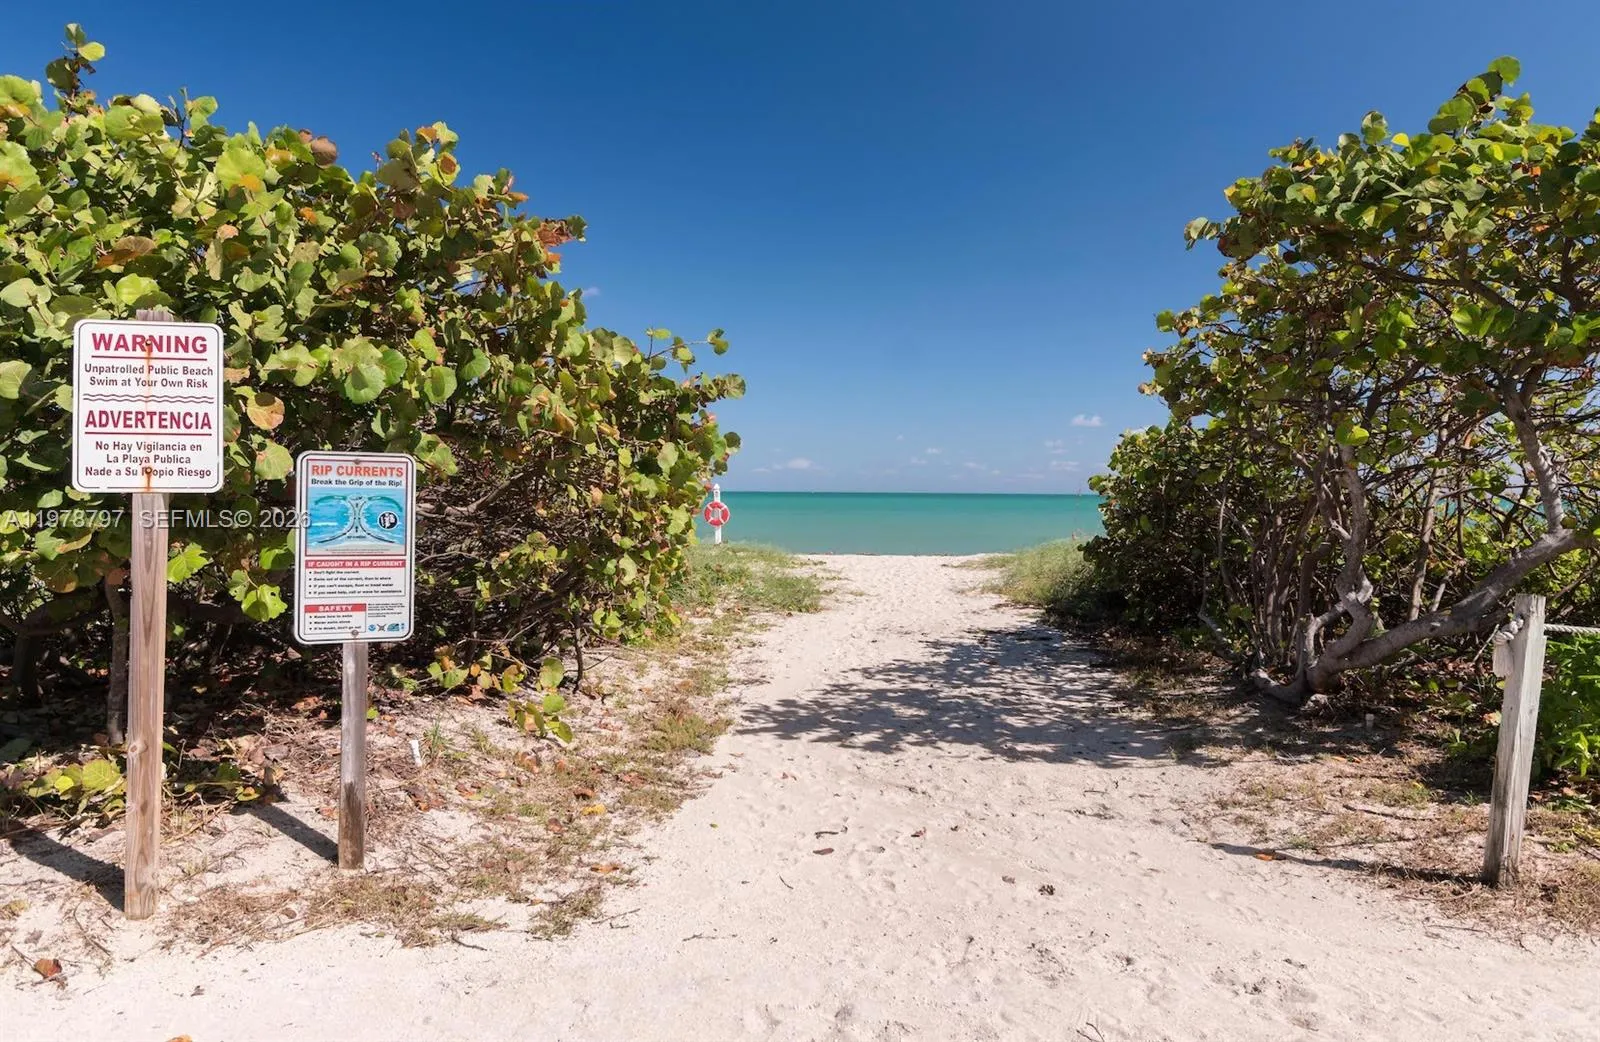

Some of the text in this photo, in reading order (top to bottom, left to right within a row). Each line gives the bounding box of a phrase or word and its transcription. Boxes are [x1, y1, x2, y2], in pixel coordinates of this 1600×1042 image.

[92, 333, 207, 353] WARNING
[84, 363, 213, 376] Unpatrolled Public Beach
[89, 376, 208, 388] Swim at Your Own Risk
[84, 410, 212, 430] ADVERTENCIA
[96, 441, 109, 450] No
[113, 441, 132, 453] Hay
[136, 441, 186, 453] Vigilancia
[106, 454, 191, 466] La Playa Publica
[85, 467, 111, 476] Nade
[125, 467, 138, 476] Su
[141, 467, 174, 479] Popio
[177, 467, 211, 479] Riesgo
[311, 465, 403, 477] RIP CURRENTS
